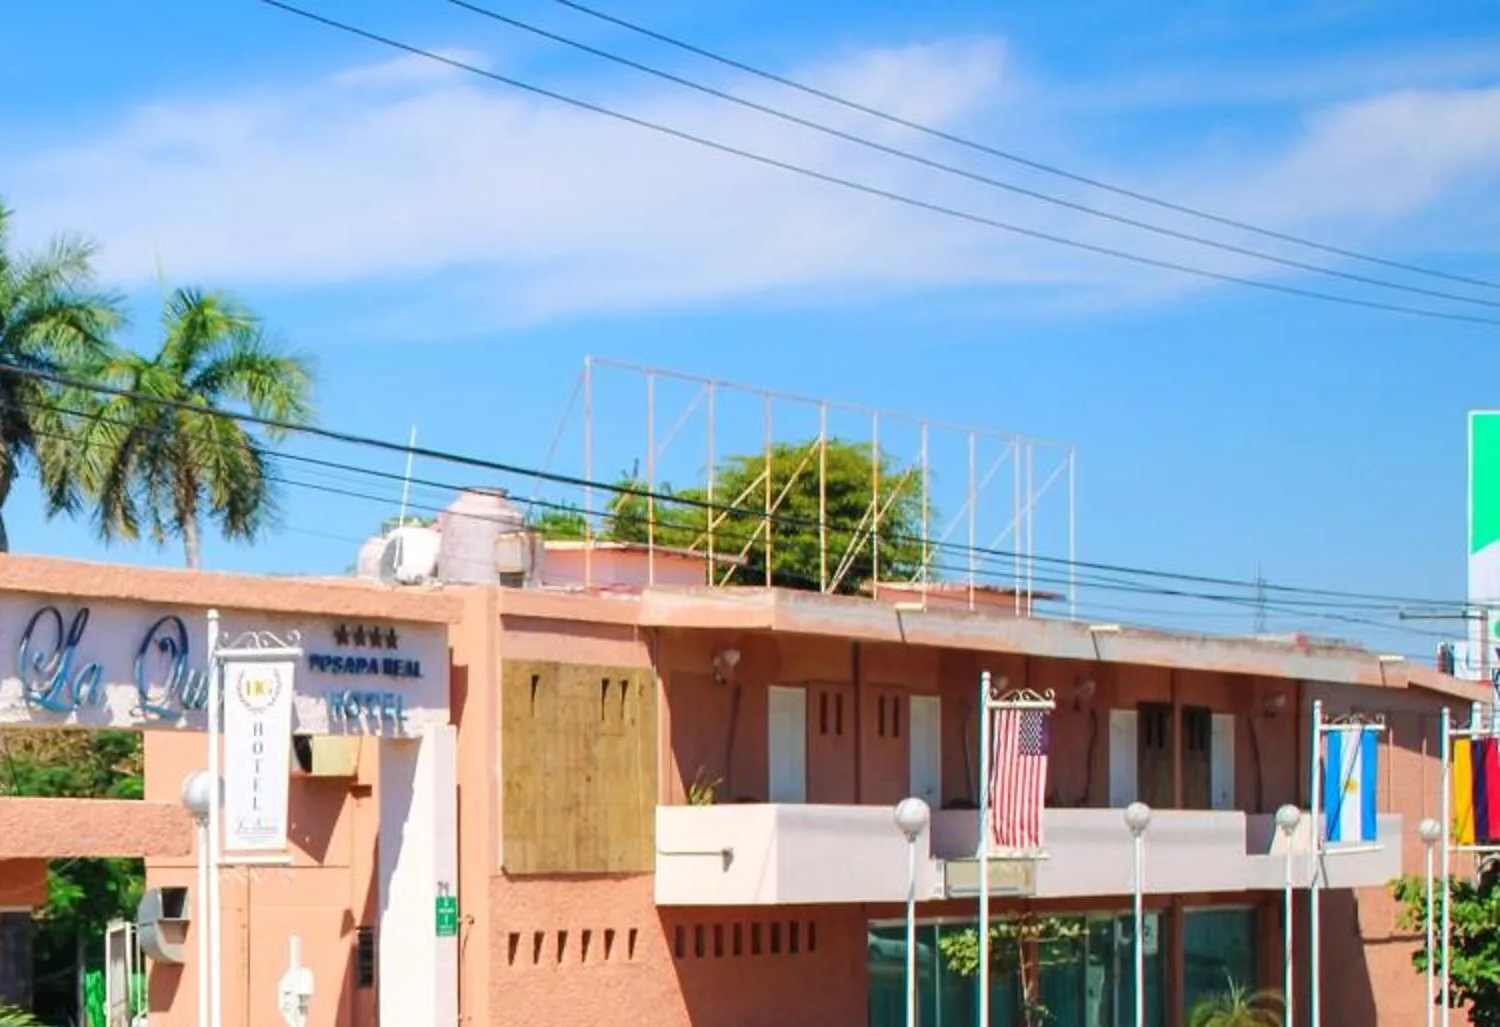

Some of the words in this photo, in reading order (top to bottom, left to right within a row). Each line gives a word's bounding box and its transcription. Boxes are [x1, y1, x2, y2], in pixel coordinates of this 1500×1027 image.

[19, 606, 105, 713] La
[329, 689, 407, 721] HOTEL
[252, 721, 264, 811] HOTEL
